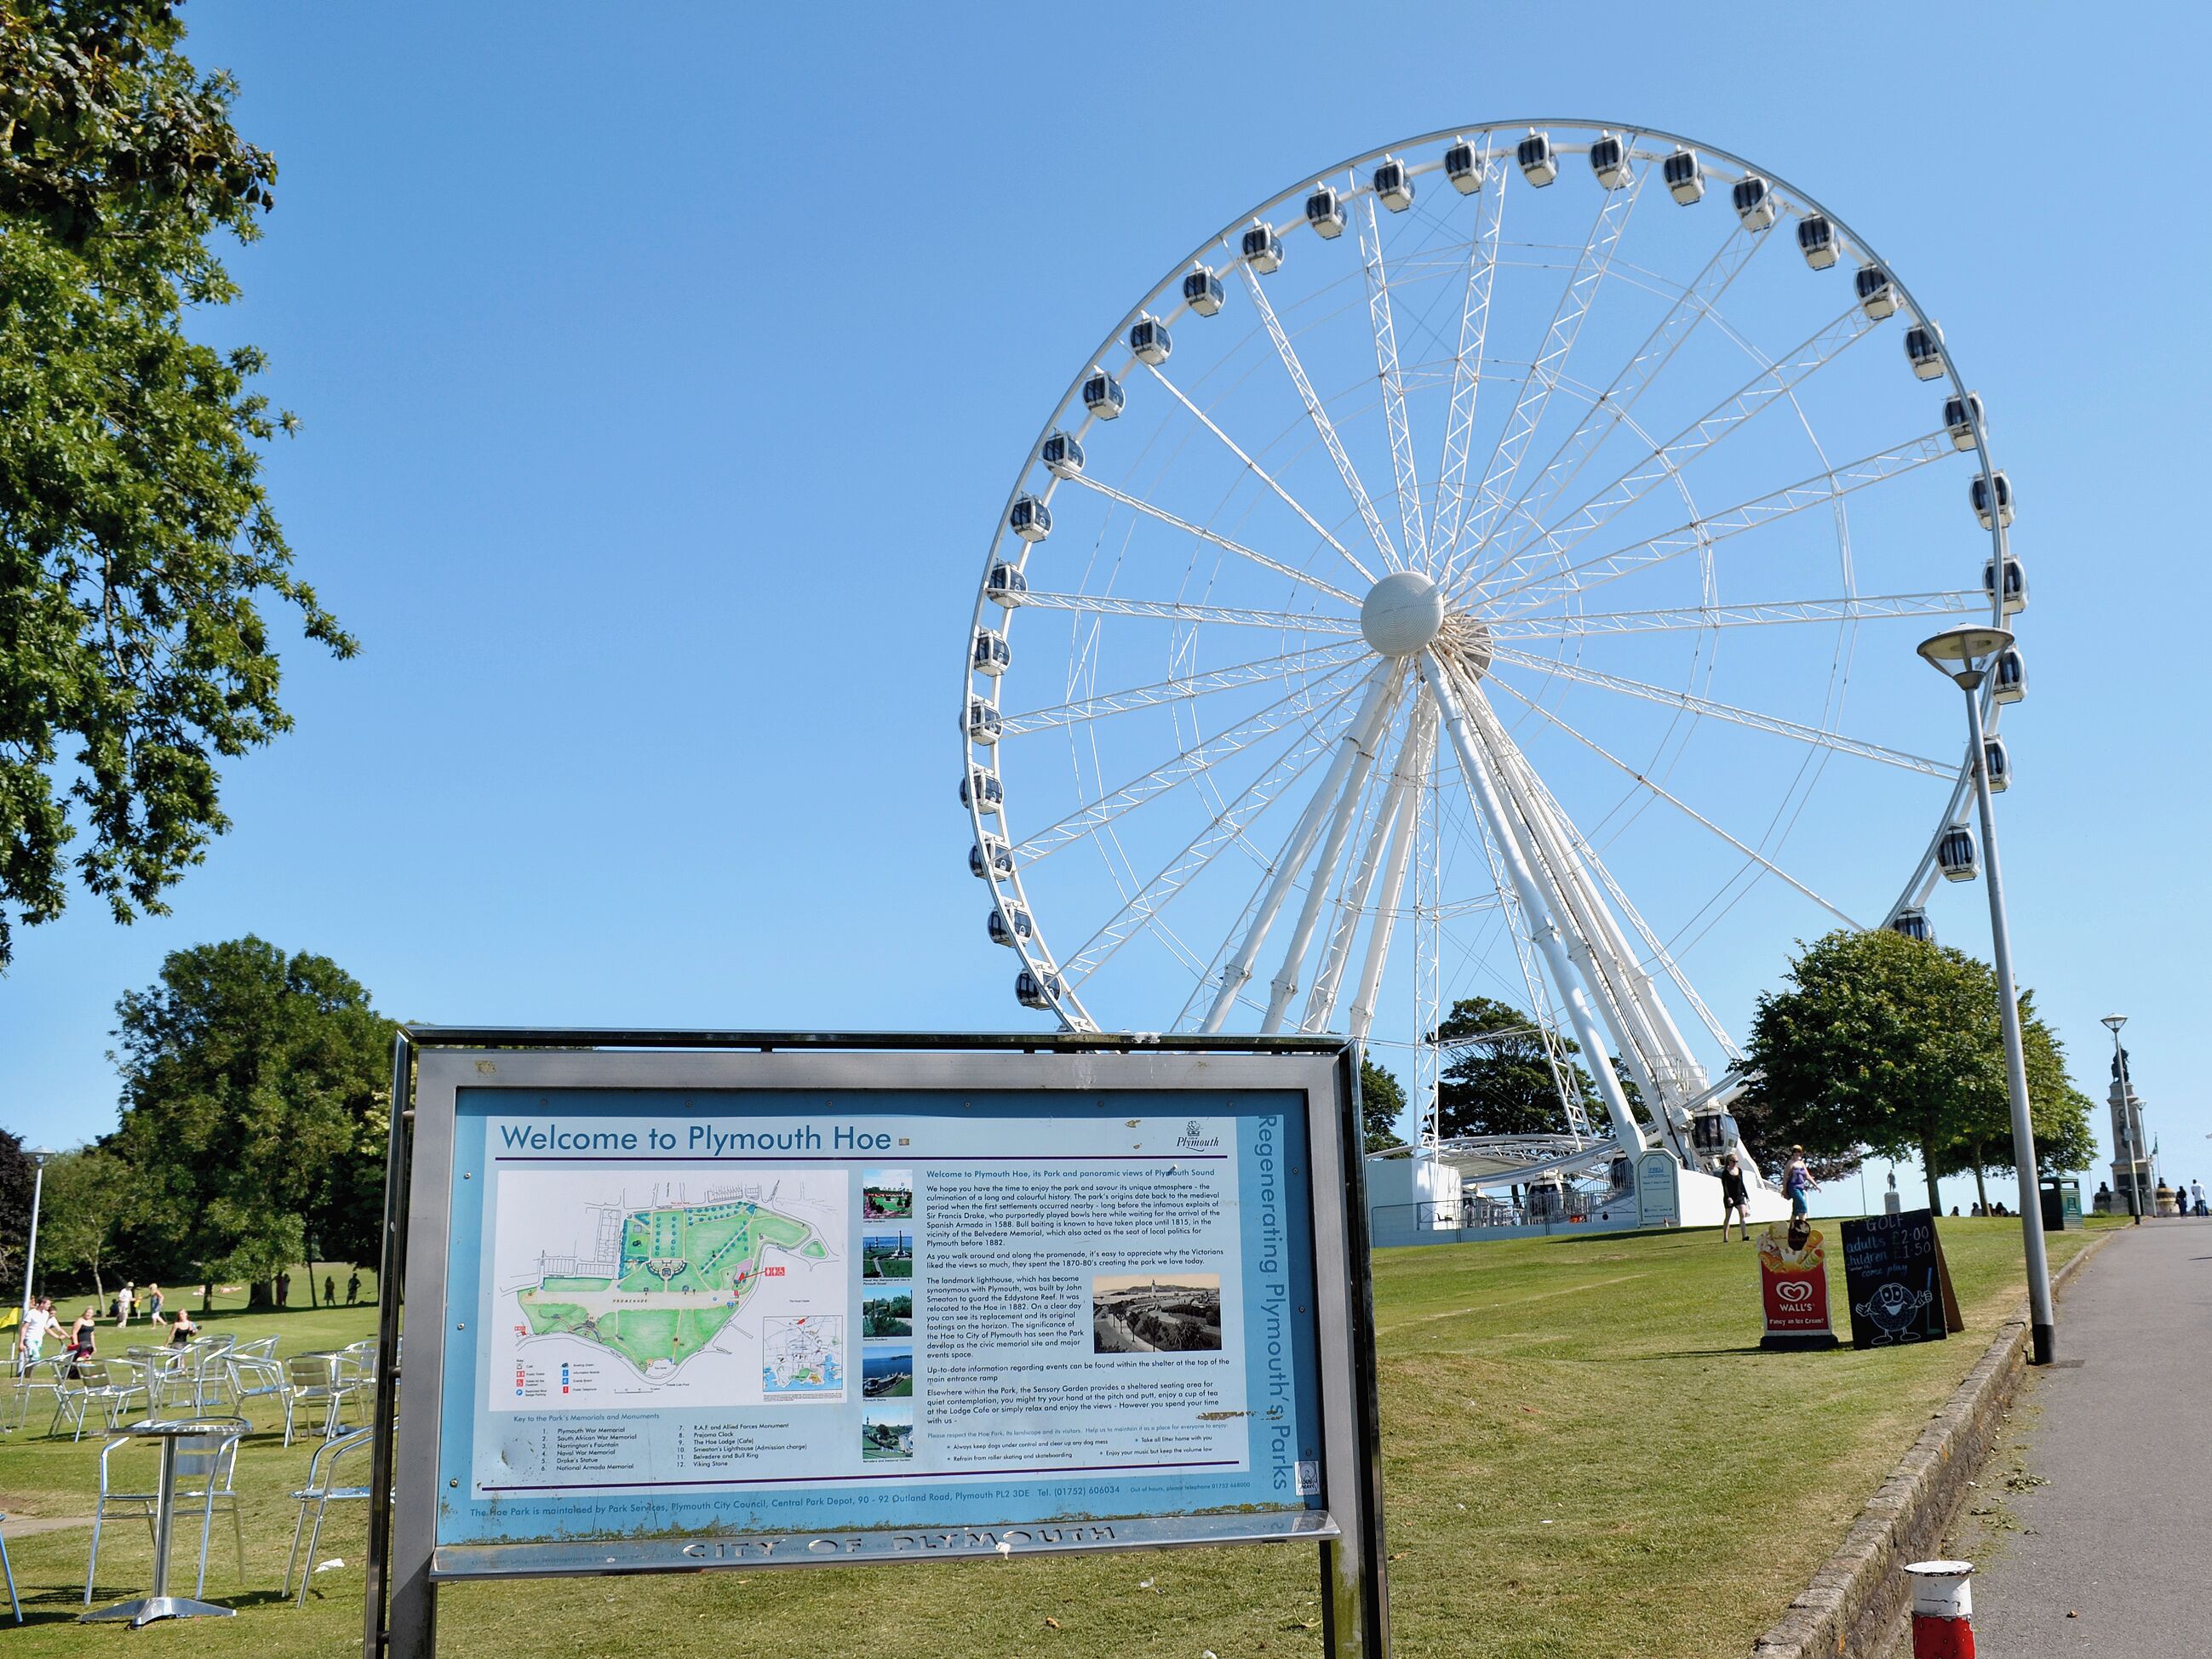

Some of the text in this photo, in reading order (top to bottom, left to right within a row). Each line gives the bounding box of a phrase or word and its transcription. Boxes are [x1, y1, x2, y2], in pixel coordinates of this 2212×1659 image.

[501, 1125, 891, 1156] Welcome to Plymouth Hoe
[1177, 1137, 1219, 1151] Plymouth
[974, 1170, 1009, 1178] Plymouth
[1079, 1169, 1120, 1178] panoramic
[1155, 1169, 1189, 1177] Plymouth
[926, 1221, 953, 1229] Spanish
[1031, 1220, 1054, 1228] baiting
[1135, 1219, 1152, 1227] place
[1866, 1214, 1903, 1232] GOLF
[1847, 1236, 1886, 1253] adults
[1012, 1260, 1027, 1268] they
[1029, 1260, 1047, 1268] spent
[1099, 1258, 1126, 1267] creating
[1140, 1258, 1155, 1266] park
[1184, 1257, 1204, 1266] today.
[968, 1294, 989, 1303] guard
[1004, 1294, 1038, 1302] Eddystone
[1254, 1116, 1292, 1490] Regenerating Plymouth's Parks
[966, 1331, 979, 1340] City
[990, 1330, 1022, 1339] Plymouth
[470, 1508, 487, 1517] The
[490, 1508, 508, 1516] Hoe
[542, 1505, 592, 1515] maintained
[596, 1505, 606, 1514] by
[609, 1504, 627, 1513] Park
[630, 1503, 668, 1513] Services,
[671, 1501, 710, 1512] Plymouth
[714, 1501, 731, 1510] City
[733, 1500, 768, 1509] Council,
[772, 1498, 803, 1507] Central
[806, 1498, 824, 1506] Park
[827, 1496, 855, 1507] Depot,
[892, 1493, 926, 1503] Outland
[929, 1492, 952, 1501] Road,
[955, 1490, 993, 1501] Plymouth
[996, 1490, 1010, 1498] PL2
[1013, 1489, 1029, 1497] 3DE
[1038, 1488, 1051, 1497] Tel.
[1054, 1487, 1086, 1496] (01752)
[1088, 1486, 1120, 1494] 606034
[682, 1527, 1115, 1557] CITY OF PLYMOUTH
